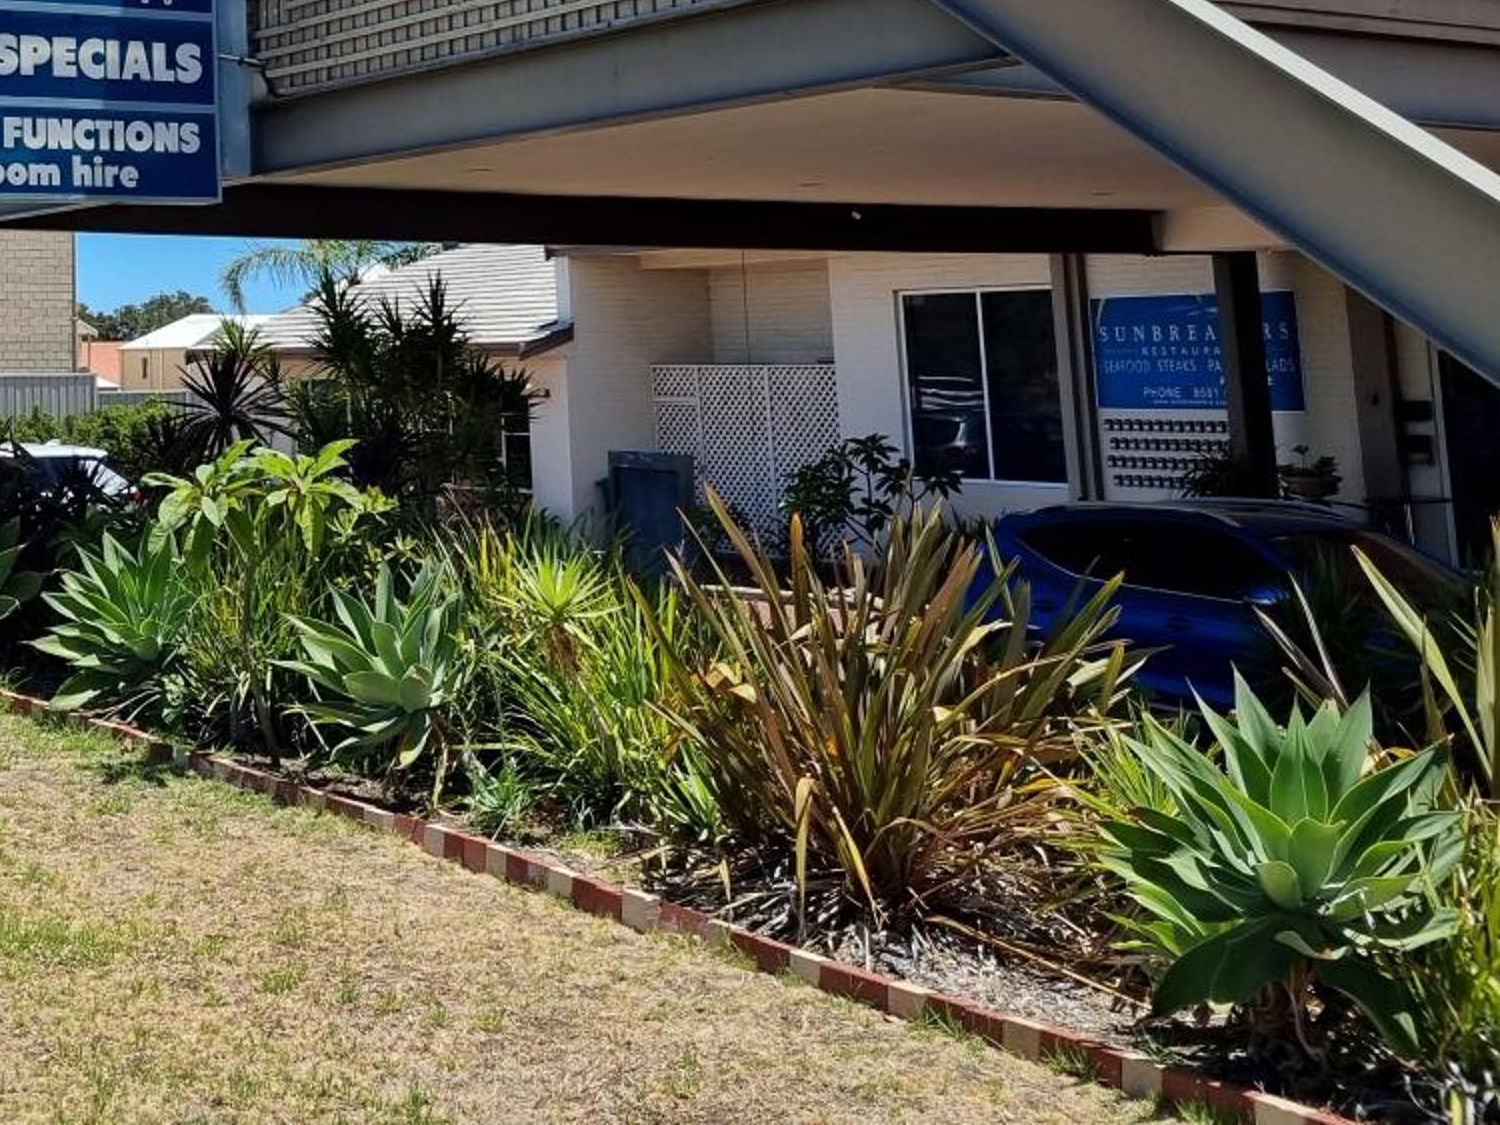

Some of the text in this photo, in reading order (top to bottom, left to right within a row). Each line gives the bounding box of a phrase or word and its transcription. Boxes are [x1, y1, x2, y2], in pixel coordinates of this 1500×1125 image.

[3, 116, 200, 154] FUNCTIONS
[72, 155, 140, 188] hire
[1099, 322, 1289, 342] SUNBREARS
